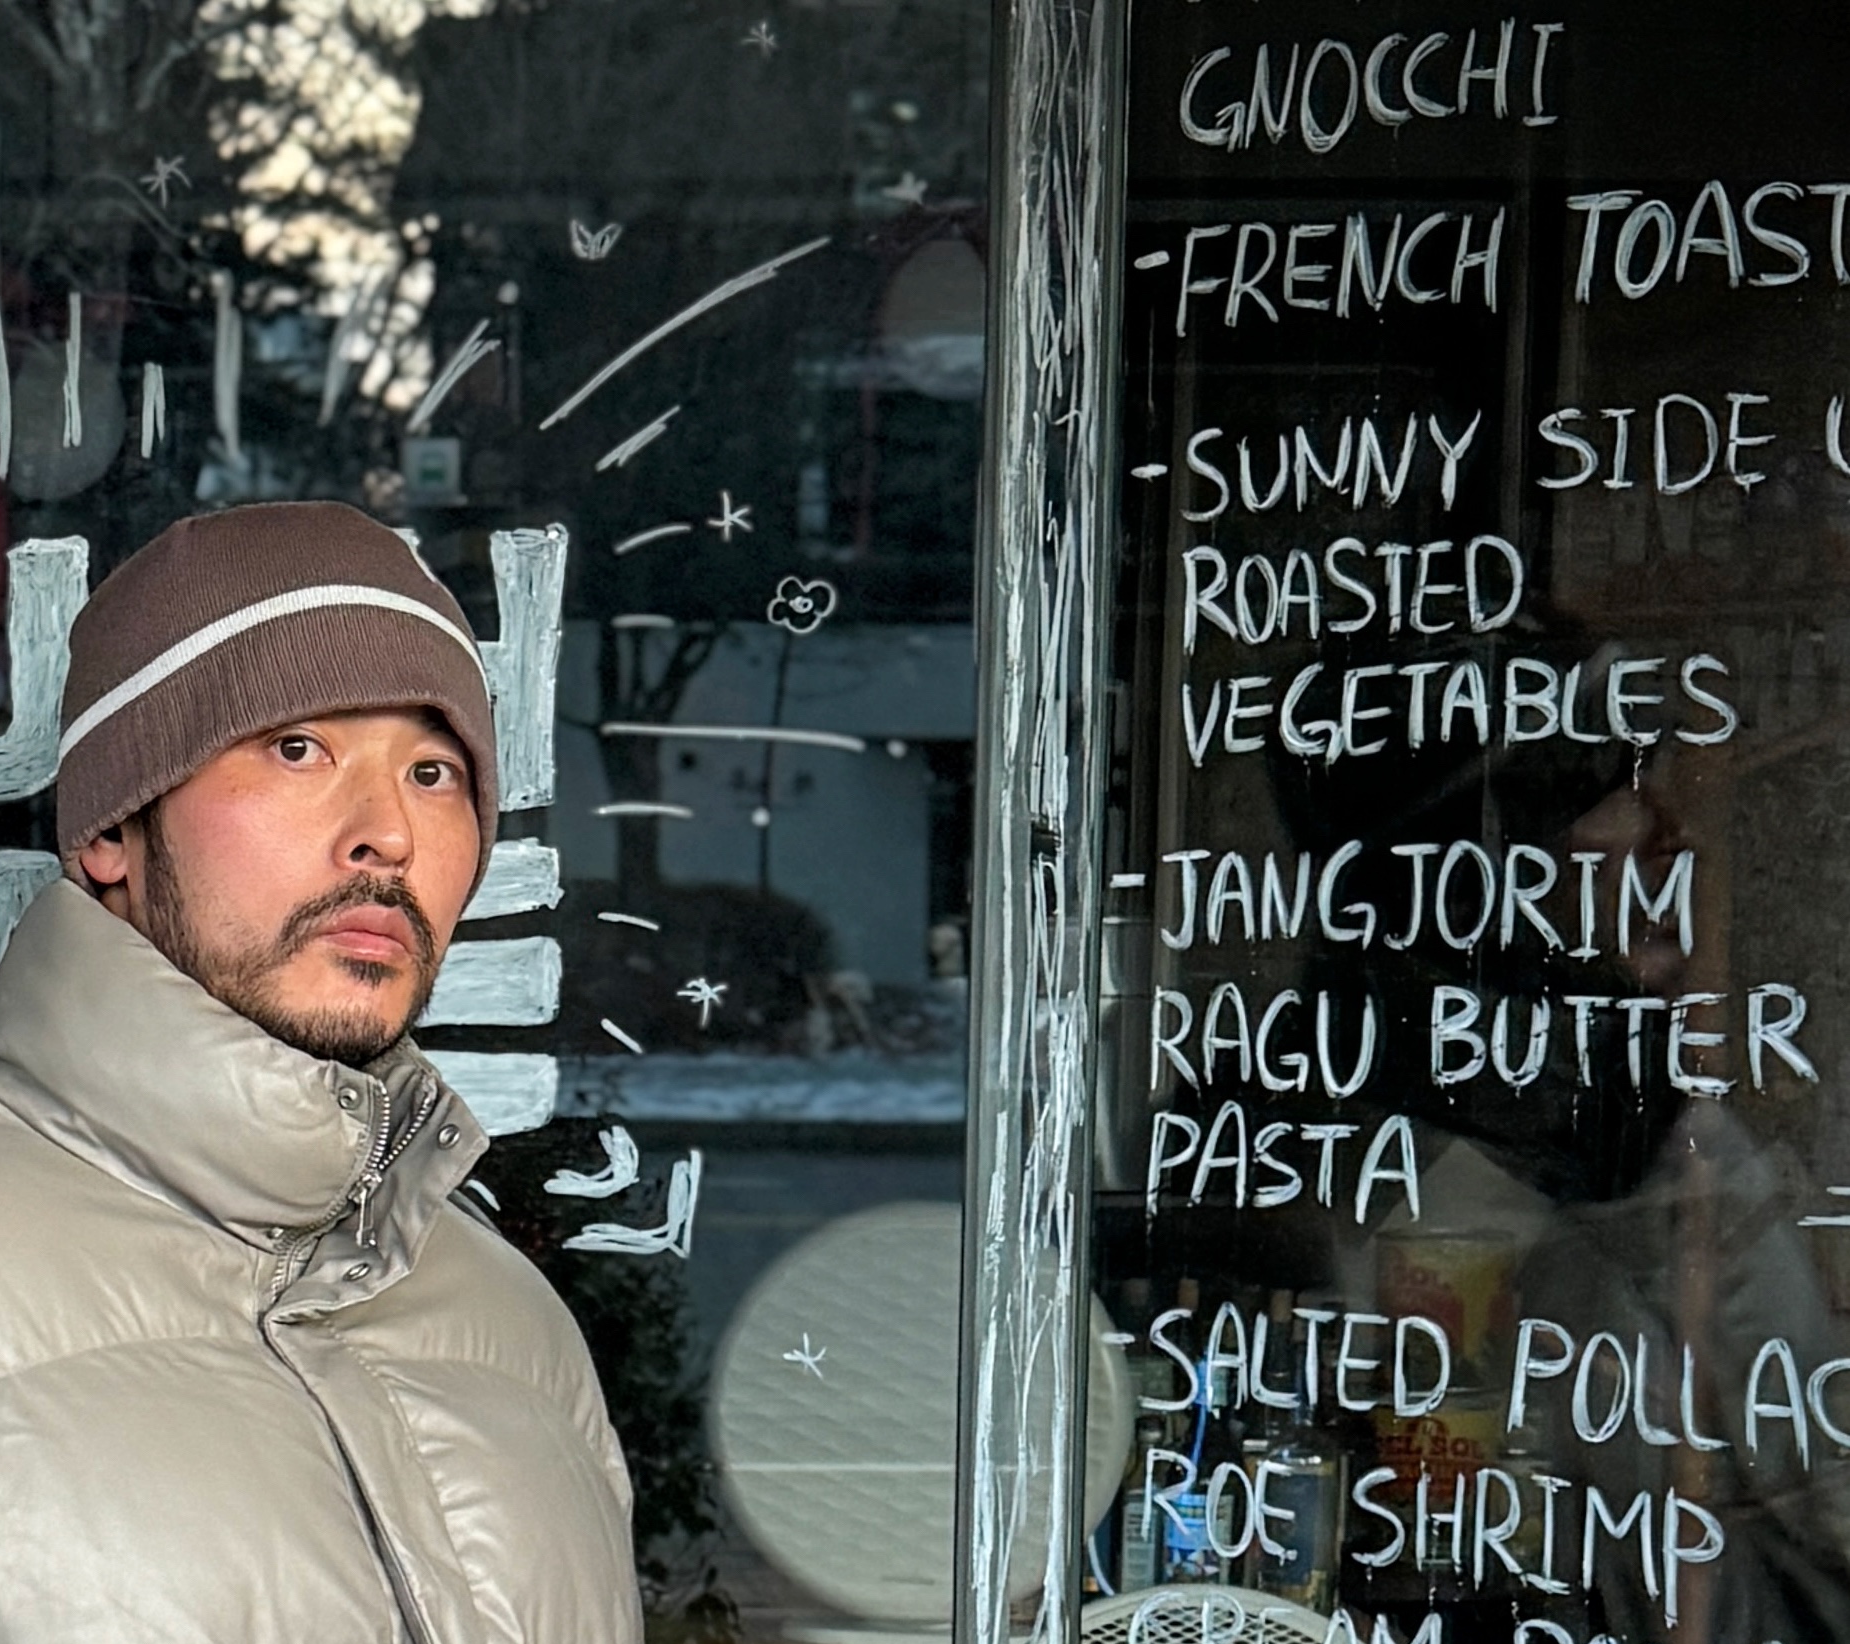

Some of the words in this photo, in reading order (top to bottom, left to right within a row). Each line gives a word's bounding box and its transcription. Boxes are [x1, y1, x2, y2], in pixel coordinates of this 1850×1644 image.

[1179, 17, 1564, 153] GNOCCHI
[1567, 181, 1850, 304] TOAST
[1537, 393, 1776, 495] SIDE
[1181, 534, 1523, 655] ROASTED
[1181, 655, 1739, 768] VEGETABLES
[1151, 982, 1377, 1099] RAGU
[1430, 984, 1820, 1095] BUTTER
[1147, 1101, 1421, 1224] PASTA
[1141, 1448, 1298, 1563] ROE
[1353, 1467, 1725, 1628] SHRIMP
